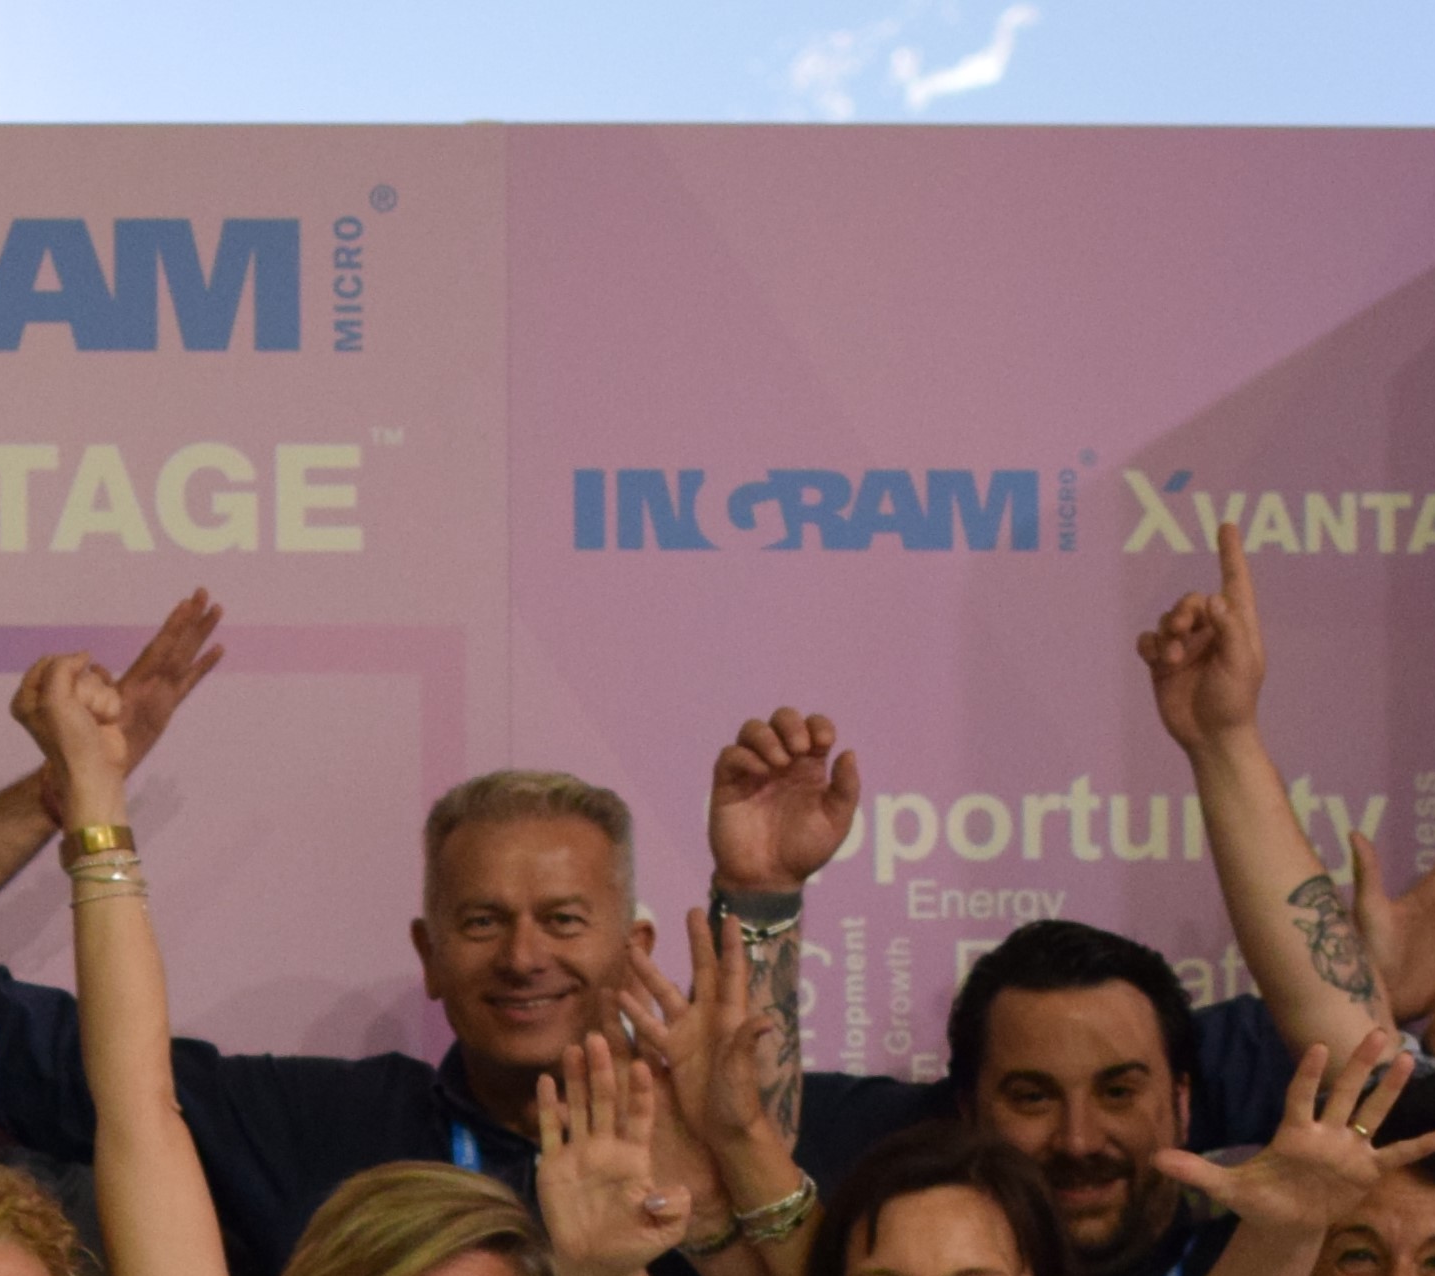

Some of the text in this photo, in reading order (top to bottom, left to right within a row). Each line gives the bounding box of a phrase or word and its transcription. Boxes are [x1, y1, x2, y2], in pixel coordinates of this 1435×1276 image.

[334, 214, 364, 353] MICRO
[572, 468, 1039, 550] INGRAM
[1055, 467, 1078, 552] MICRO
[884, 937, 913, 1055] Growth
